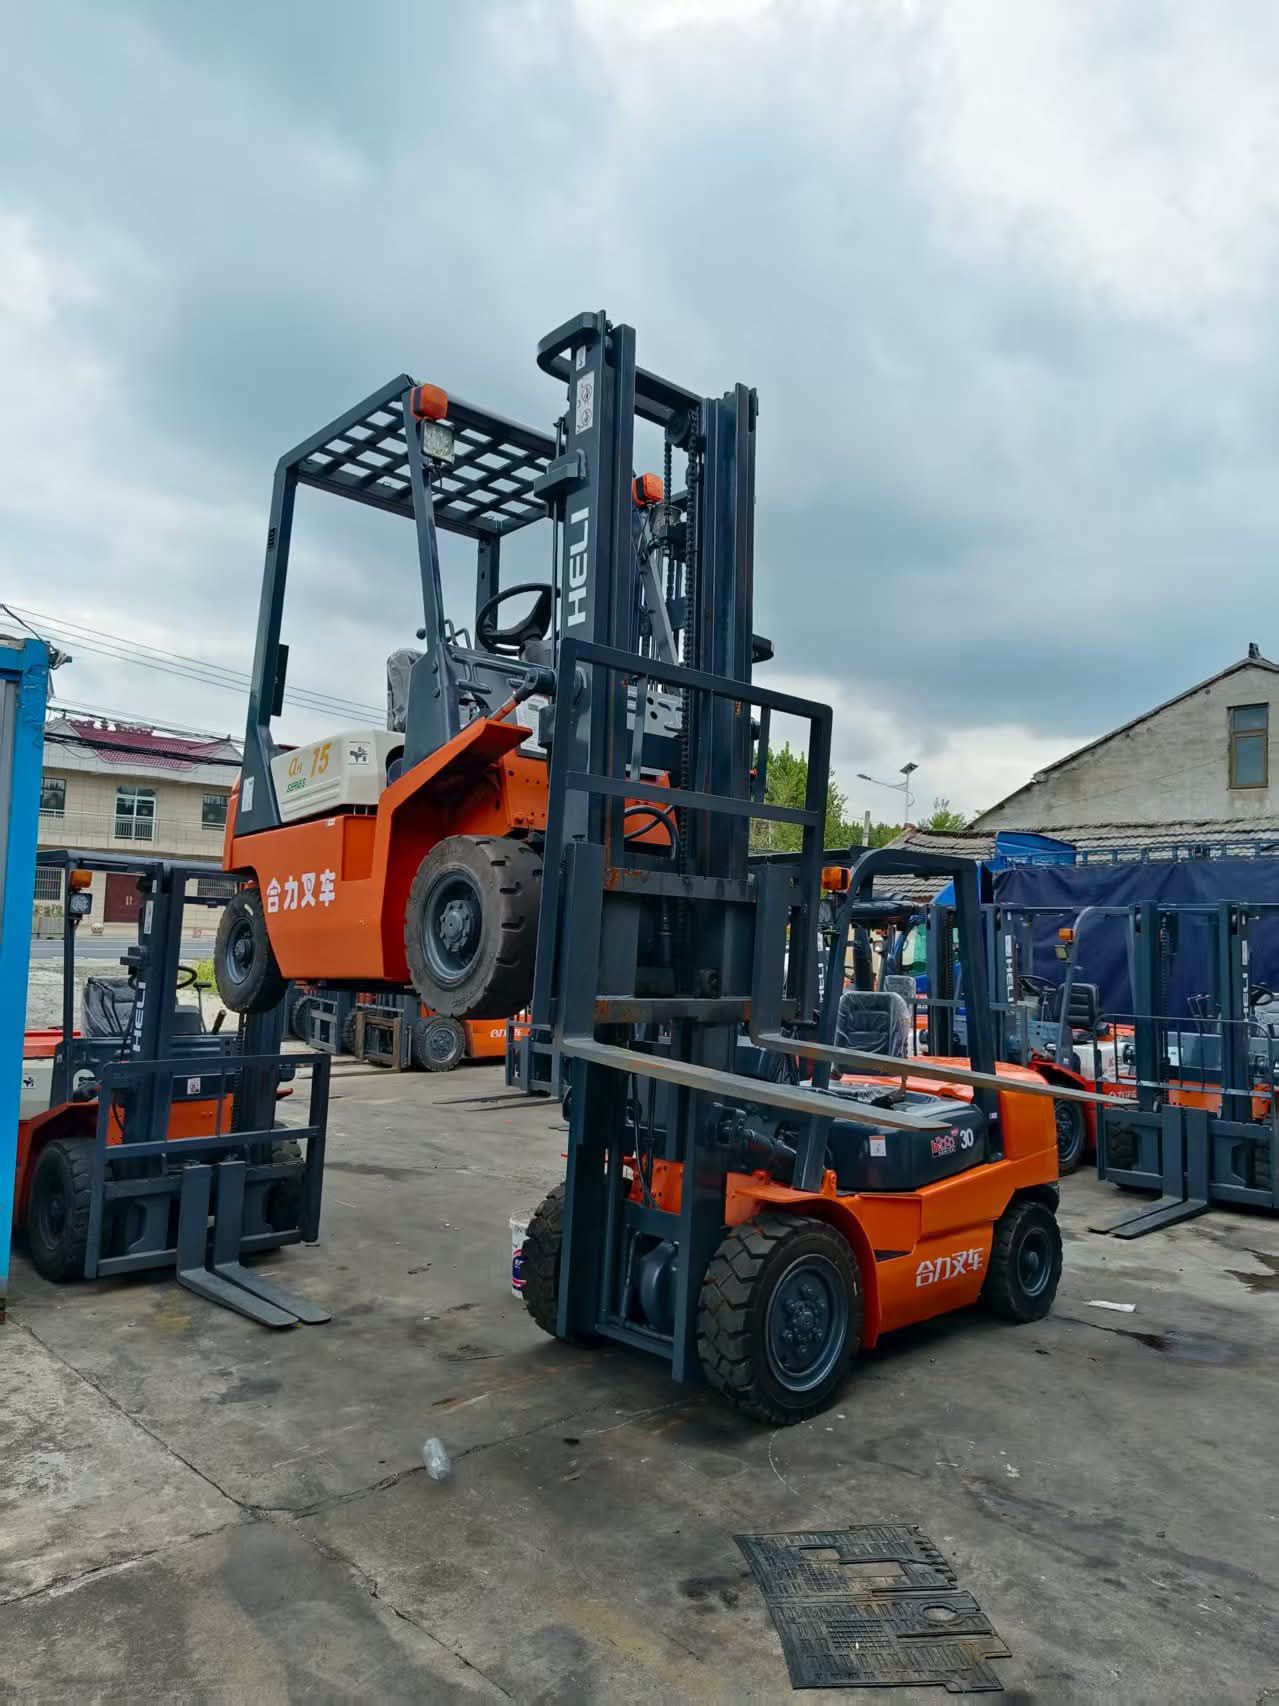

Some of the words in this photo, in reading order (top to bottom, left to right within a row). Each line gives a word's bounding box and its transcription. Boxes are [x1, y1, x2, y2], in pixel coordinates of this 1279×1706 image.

[567, 507, 589, 627] HELI
[310, 742, 332, 778] 15
[286, 777, 307, 793] SERIES
[267, 868, 336, 913] 合力叉车
[132, 981, 147, 1052] HELI
[959, 1128, 974, 1149] 30
[916, 1247, 985, 1288] 合力叉车
